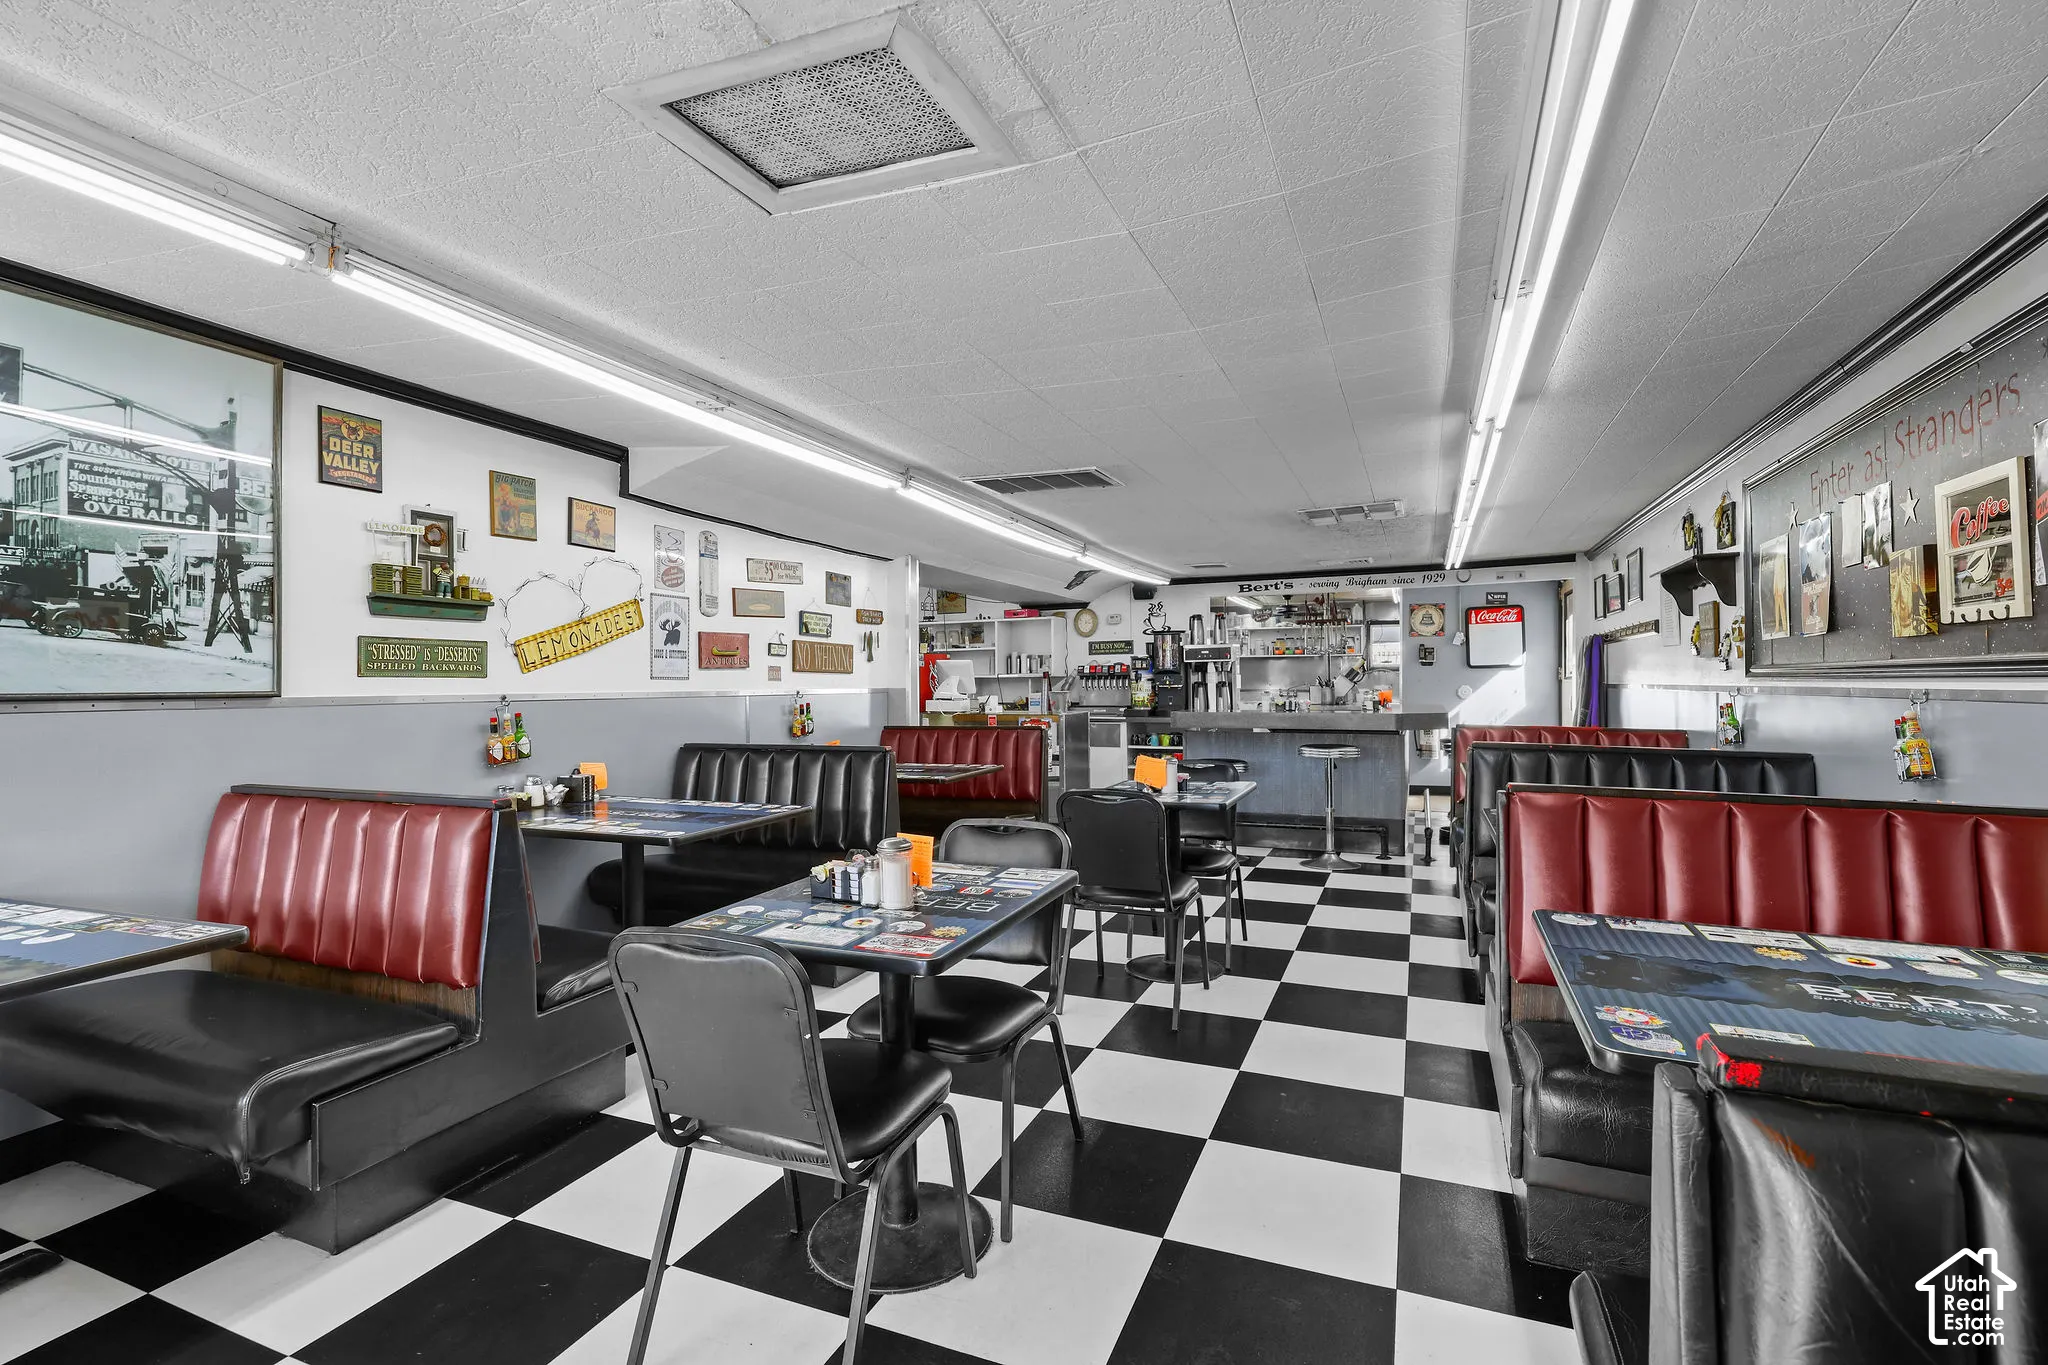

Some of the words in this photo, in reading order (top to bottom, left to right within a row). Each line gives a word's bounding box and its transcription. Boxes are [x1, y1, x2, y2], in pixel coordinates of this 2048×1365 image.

[329, 437, 375, 459] DEER
[73, 463, 91, 472] THE
[322, 451, 380, 475] VALLEY
[69, 469, 148, 490] Mountaineer
[495, 474, 509, 483] BIG
[511, 476, 534, 488] PATCH
[1809, 460, 1854, 508] Enter
[1864, 445, 1883, 483] as
[83, 500, 199, 526] OVERALLS
[1950, 496, 2010, 549] Coffee
[368, 522, 424, 534] LEMONADE
[780, 562, 799, 576] Charge
[1238, 581, 1294, 593] Bert's
[1308, 580, 1340, 590] serving
[1345, 576, 1387, 588] Brigham
[1392, 576, 1416, 584] since
[1421, 572, 1446, 583] 1929
[1477, 608, 1520, 623] Coca-Cola
[521, 614, 624, 666] LEMONADE
[424, 647, 431, 661] IS
[704, 656, 748, 666] ANTIQUES
[796, 643, 811, 670] NO
[814, 644, 853, 671] WHINING
[366, 662, 416, 671] SPELLED
[422, 663, 482, 672] BACKWARDS
